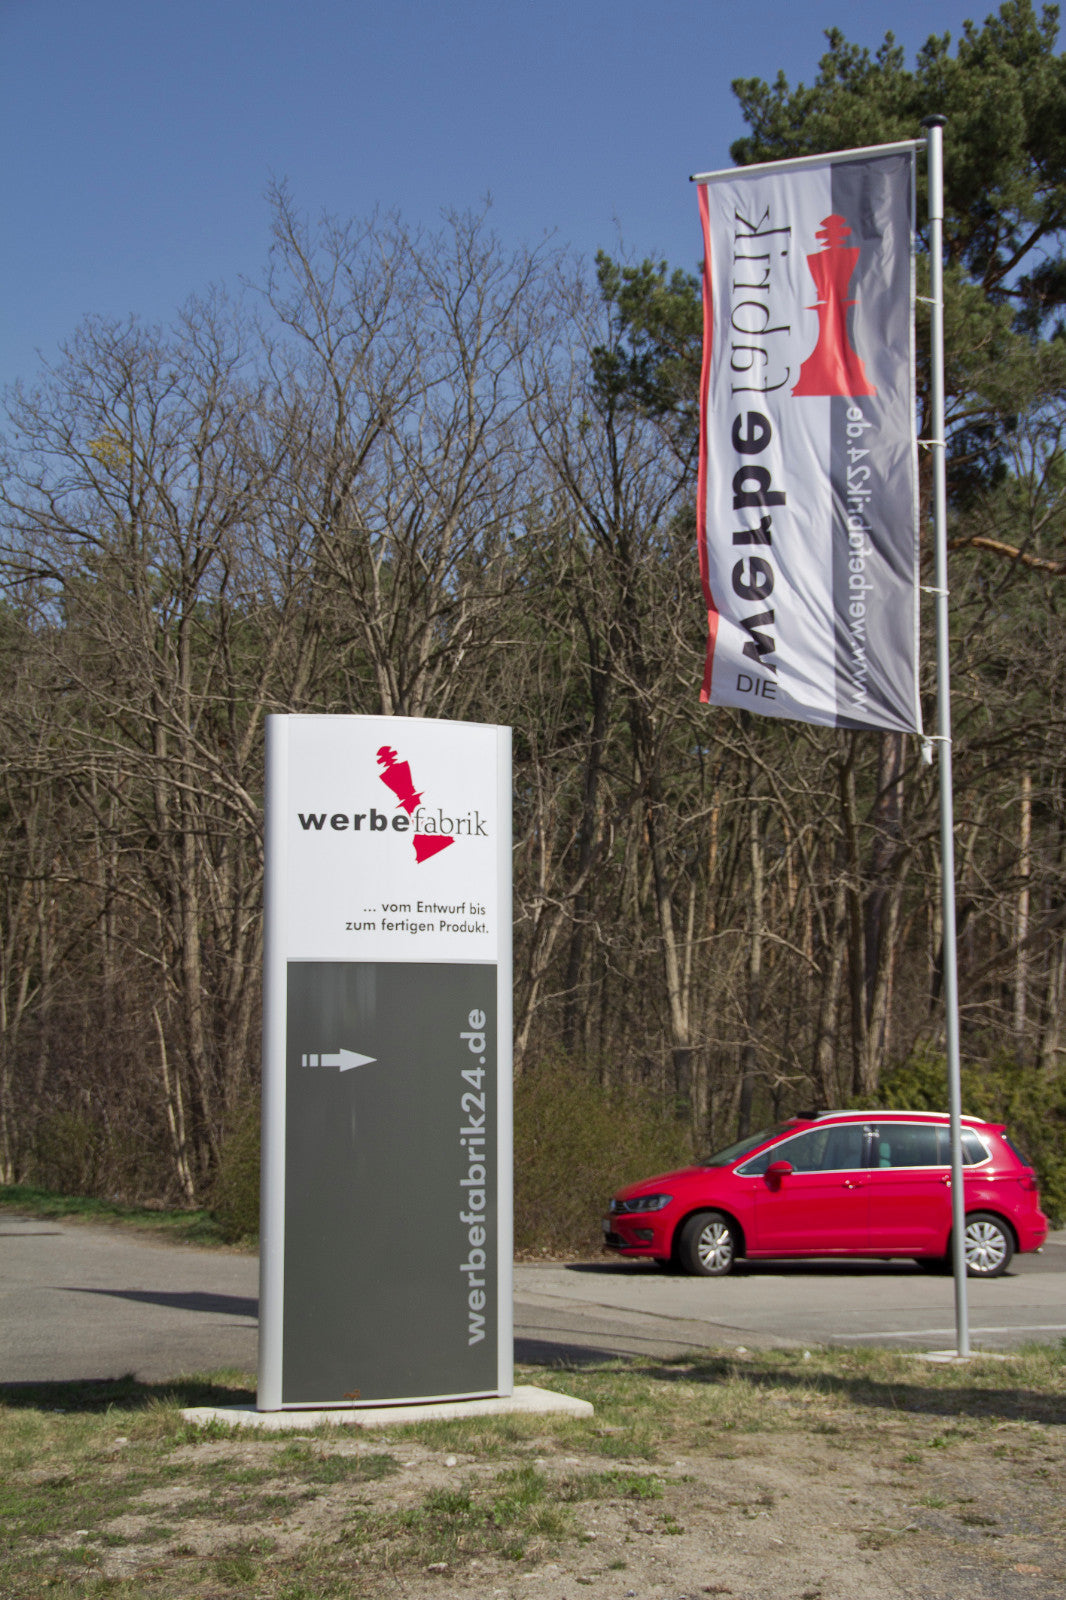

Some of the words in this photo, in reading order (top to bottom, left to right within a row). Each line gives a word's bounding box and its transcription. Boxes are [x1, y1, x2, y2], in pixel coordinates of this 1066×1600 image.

[736, 674, 778, 699] DIE
[381, 903, 412, 914] vom
[416, 901, 466, 915] Entwurf
[469, 902, 486, 916] bis
[345, 921, 376, 931] zum
[381, 918, 434, 934] fertigen
[439, 920, 489, 934] Produkt.
[459, 1007, 487, 1346] werbefabrik24.de
